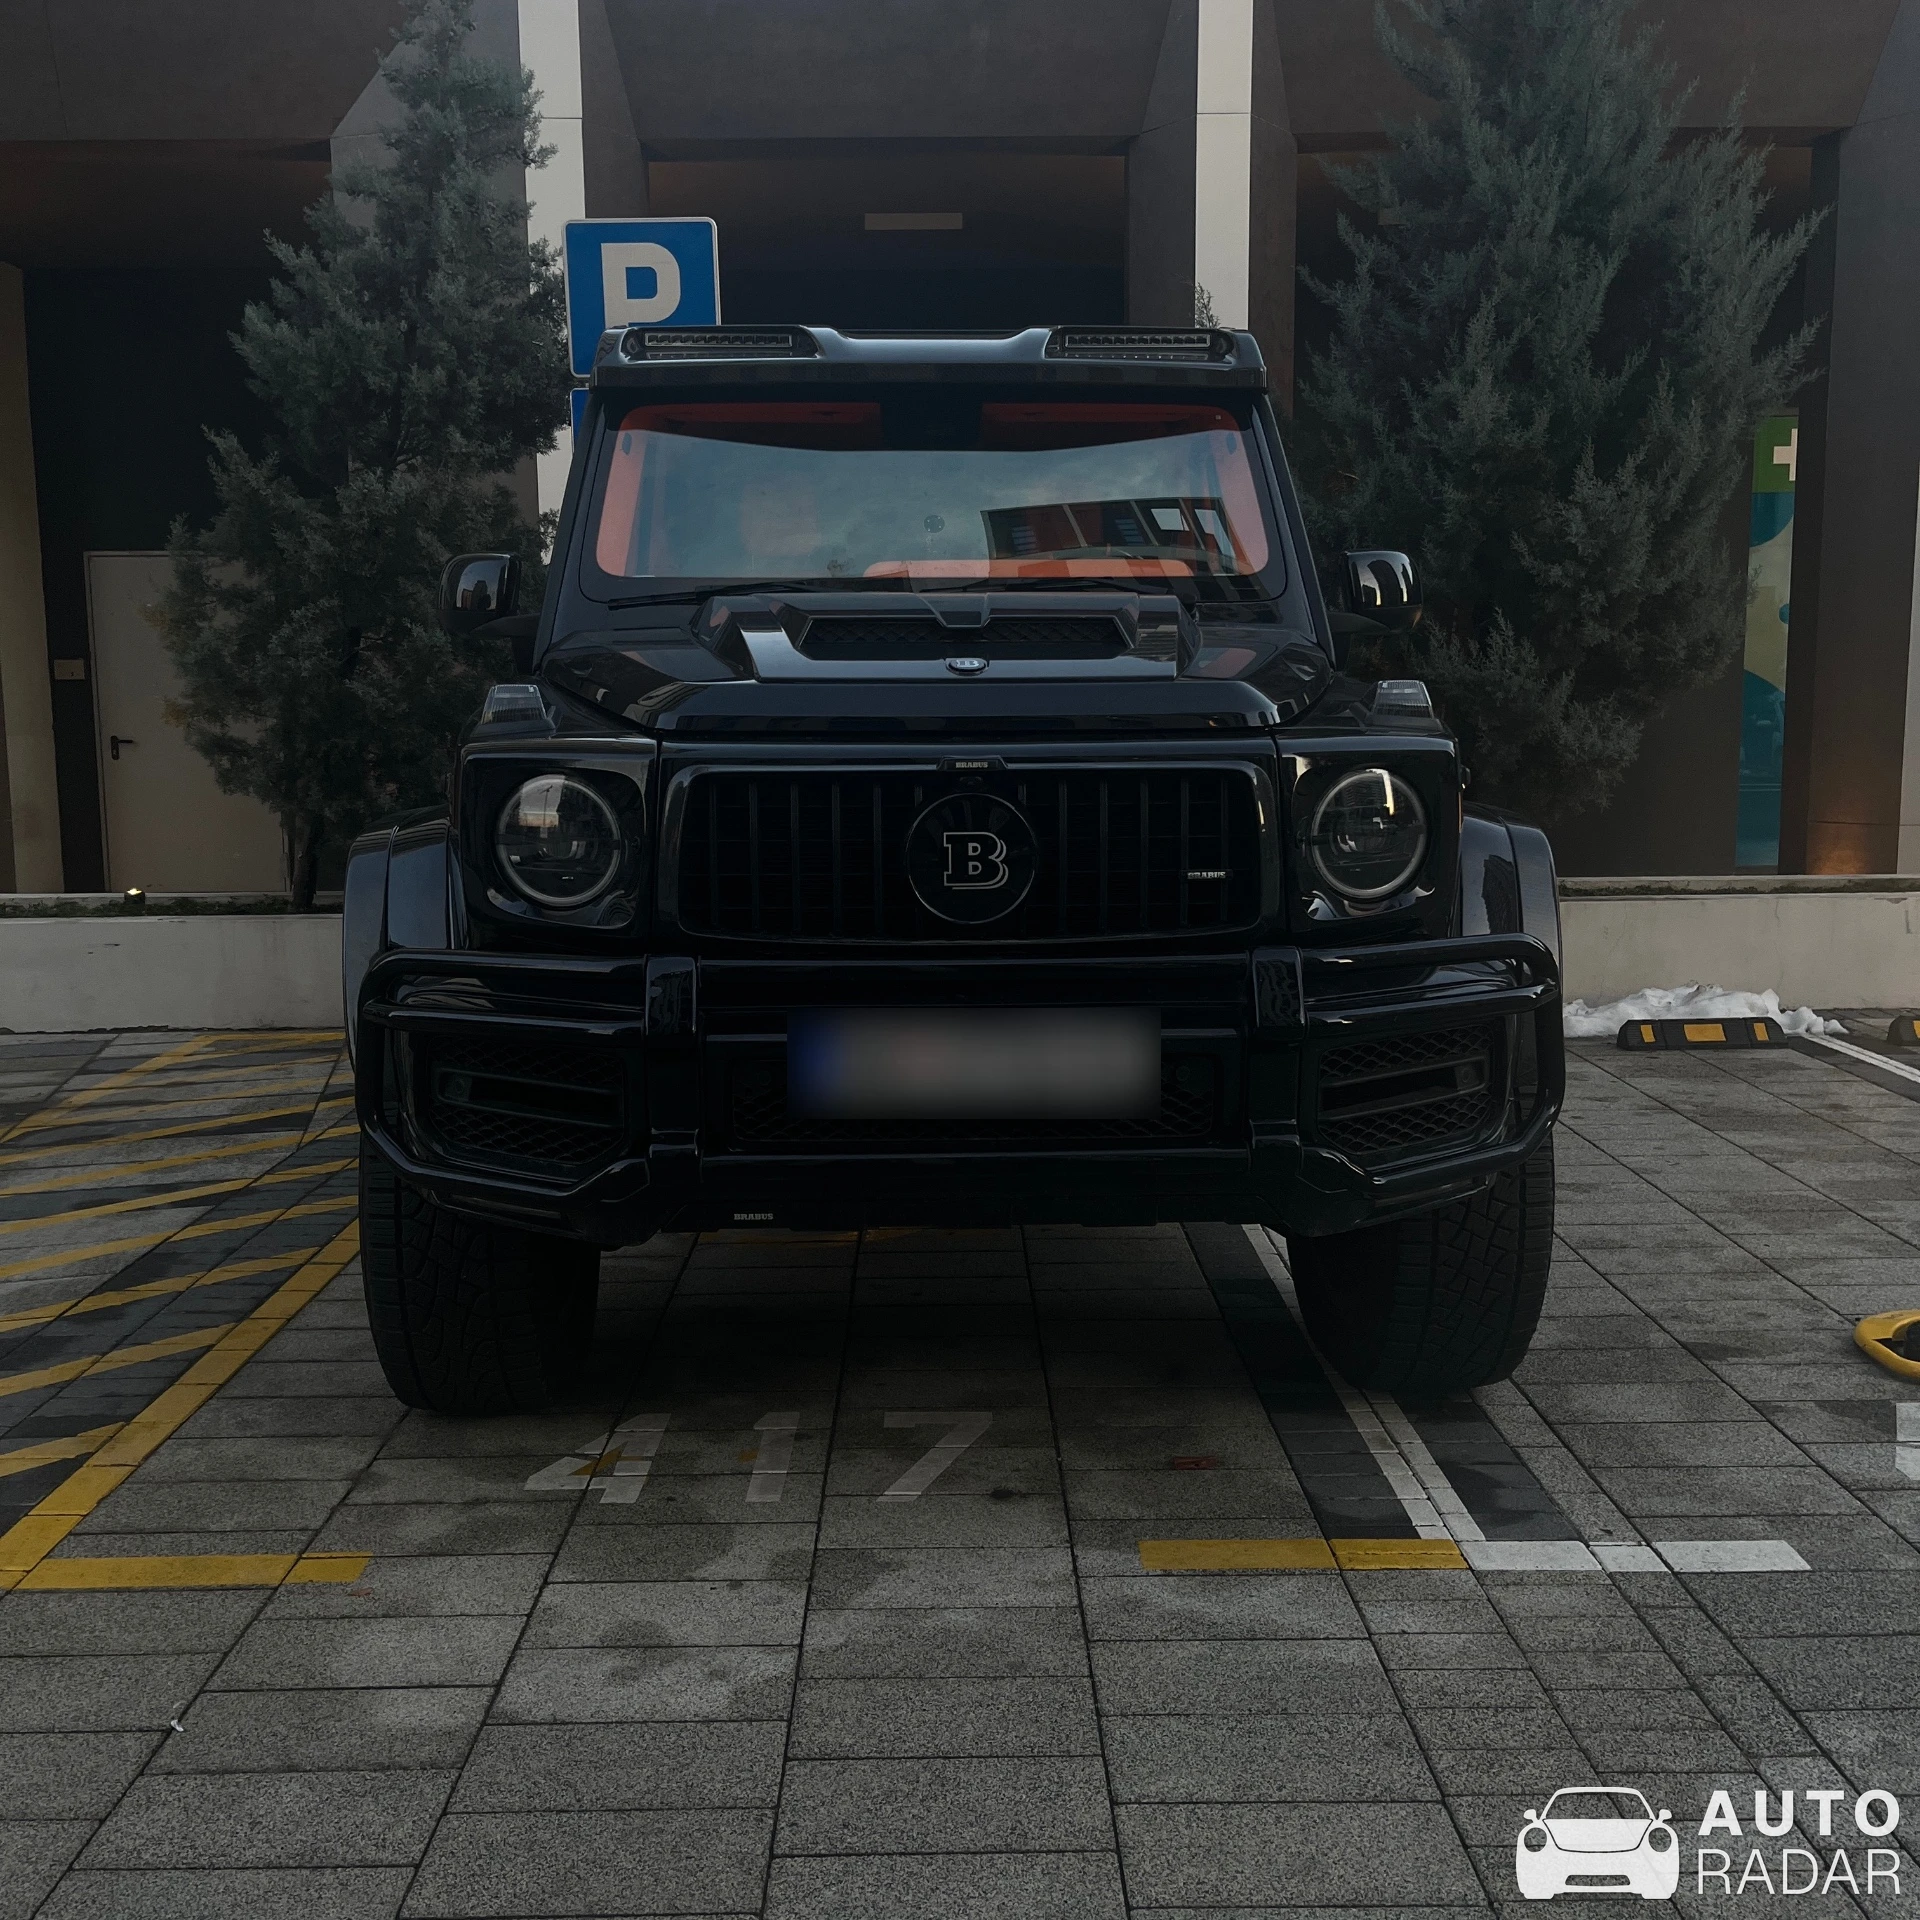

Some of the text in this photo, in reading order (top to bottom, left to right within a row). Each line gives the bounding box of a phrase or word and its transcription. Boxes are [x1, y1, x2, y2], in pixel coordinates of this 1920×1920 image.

[600, 242, 681, 329] P
[955, 761, 989, 769] BRABUS
[943, 831, 1009, 890] B
